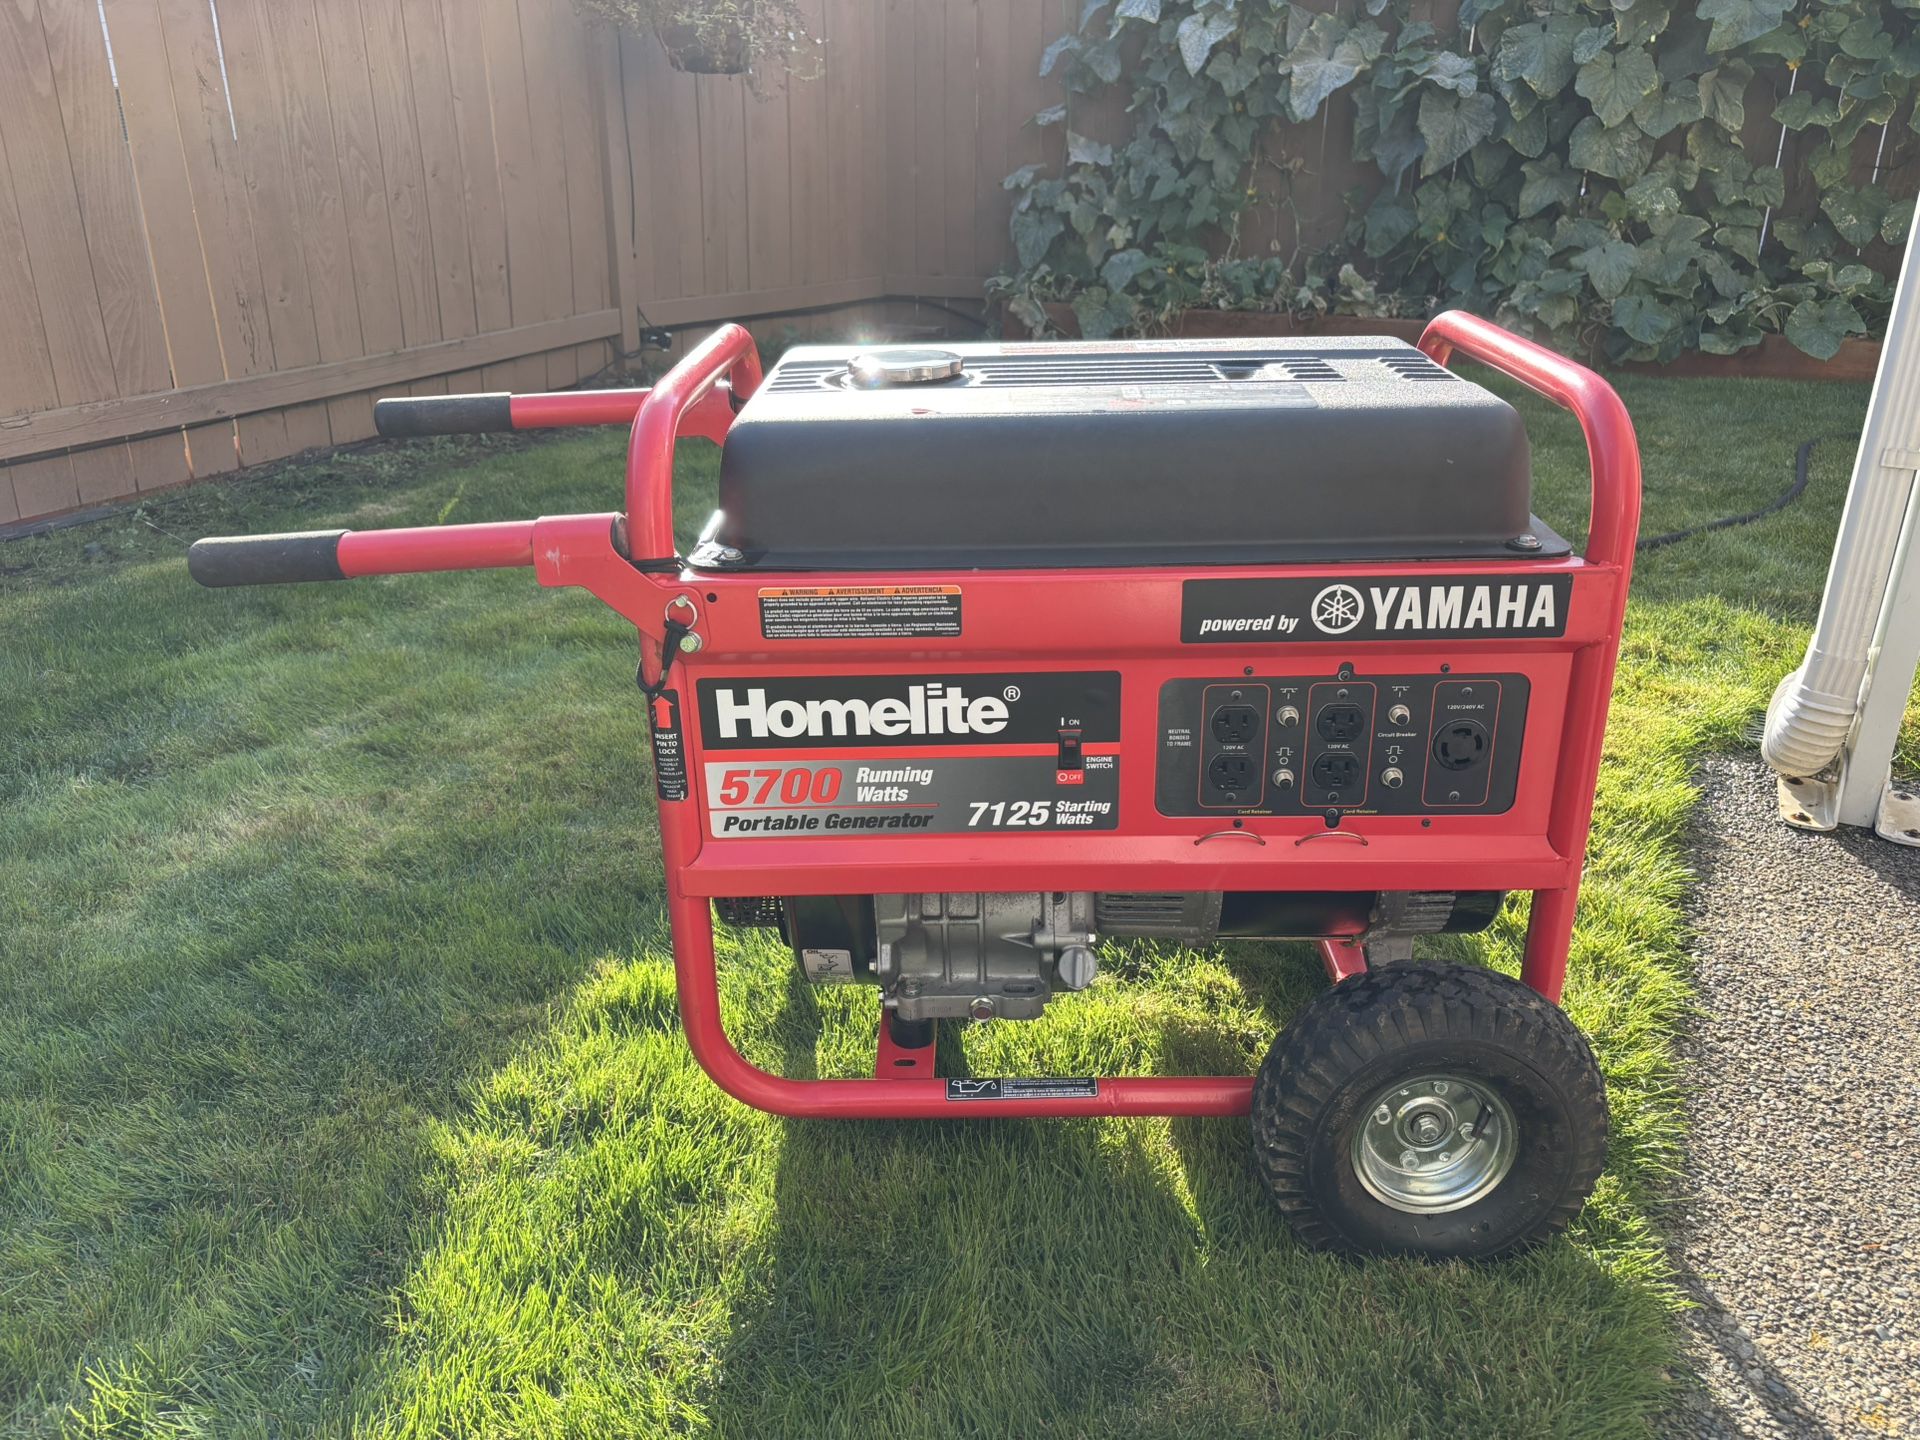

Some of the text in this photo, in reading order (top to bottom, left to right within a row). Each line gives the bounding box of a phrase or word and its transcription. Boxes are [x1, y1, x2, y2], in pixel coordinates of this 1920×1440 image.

[1369, 583, 1556, 631] YAMAHA
[1200, 614, 1299, 635] powered by
[856, 766, 934, 785] Running
[719, 767, 843, 806] 5700
[856, 786, 909, 803] Watts
[967, 801, 1052, 827] 7125
[1055, 800, 1112, 817] Starting
[723, 812, 934, 832] Portable Generator
[1055, 812, 1094, 826] Watts
